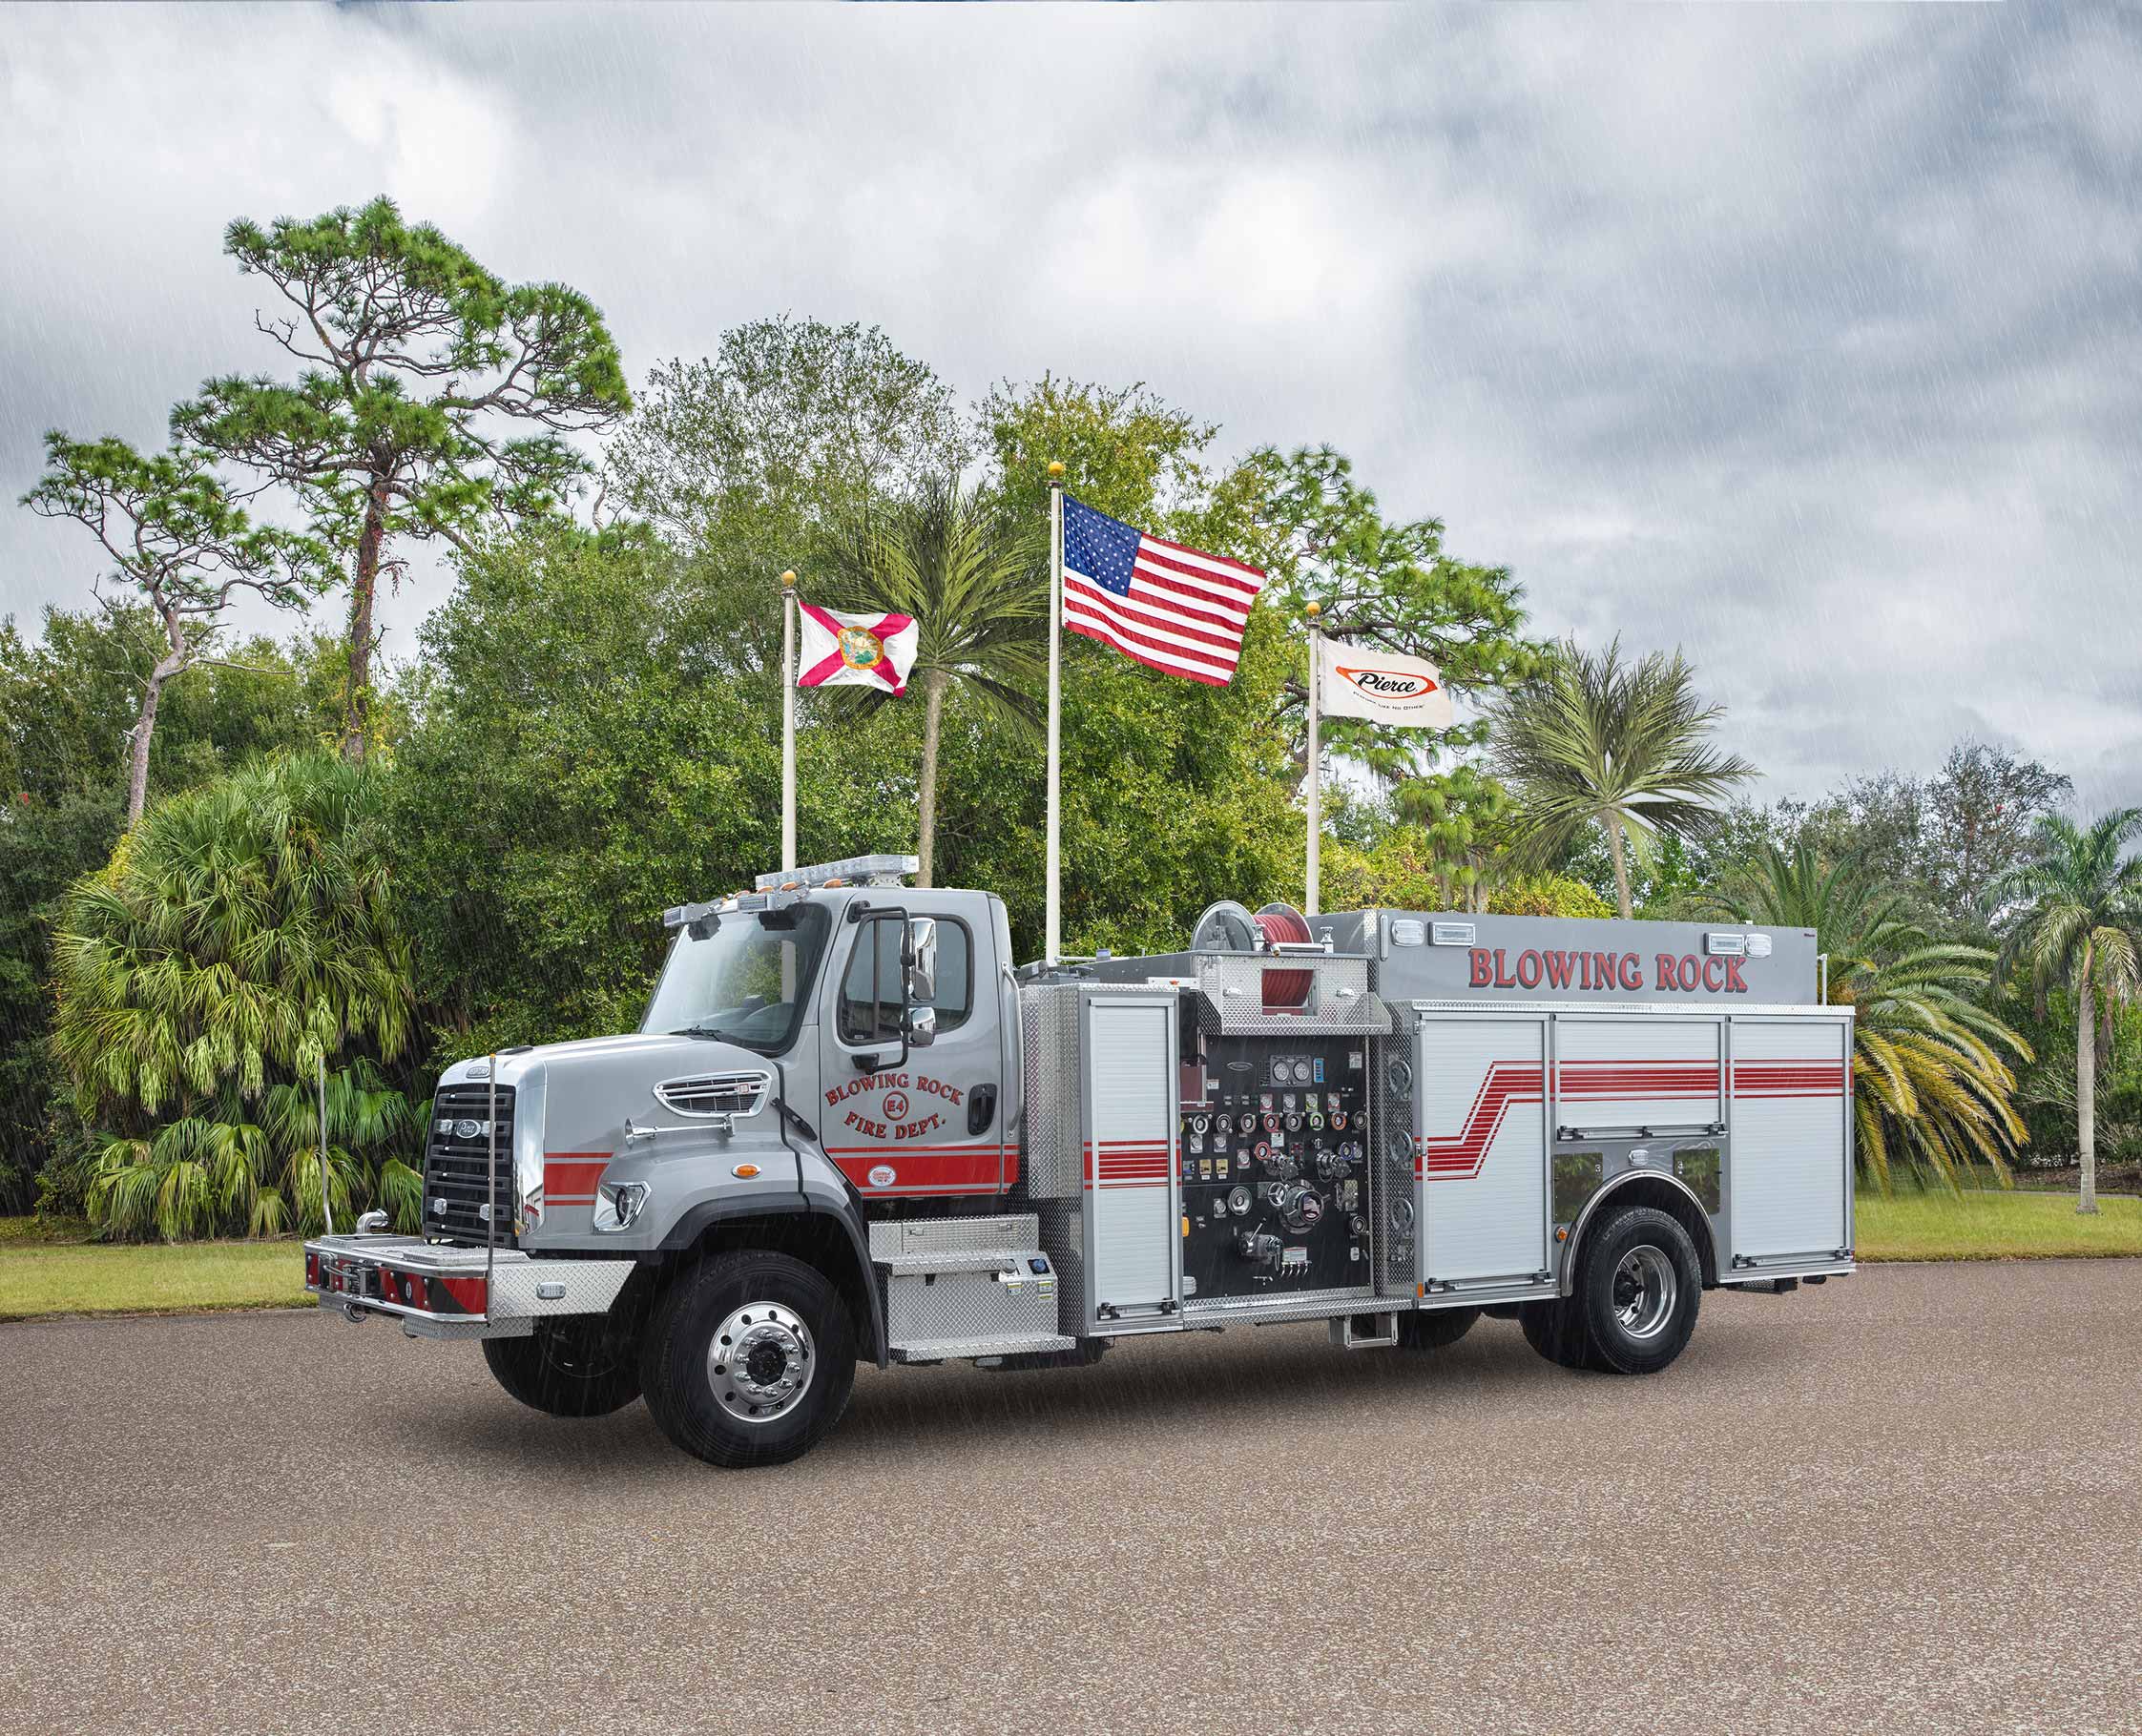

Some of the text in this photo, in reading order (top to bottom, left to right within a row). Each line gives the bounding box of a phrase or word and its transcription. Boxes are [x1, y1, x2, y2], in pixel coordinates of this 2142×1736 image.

[1358, 673, 1416, 692] Pierce
[1469, 948, 1748, 993] BLOWING ROCK
[825, 1073, 964, 1106] BLOWING ROCK
[887, 1100, 905, 1112] E4
[844, 1111, 946, 1139] FIRE DEPT.
